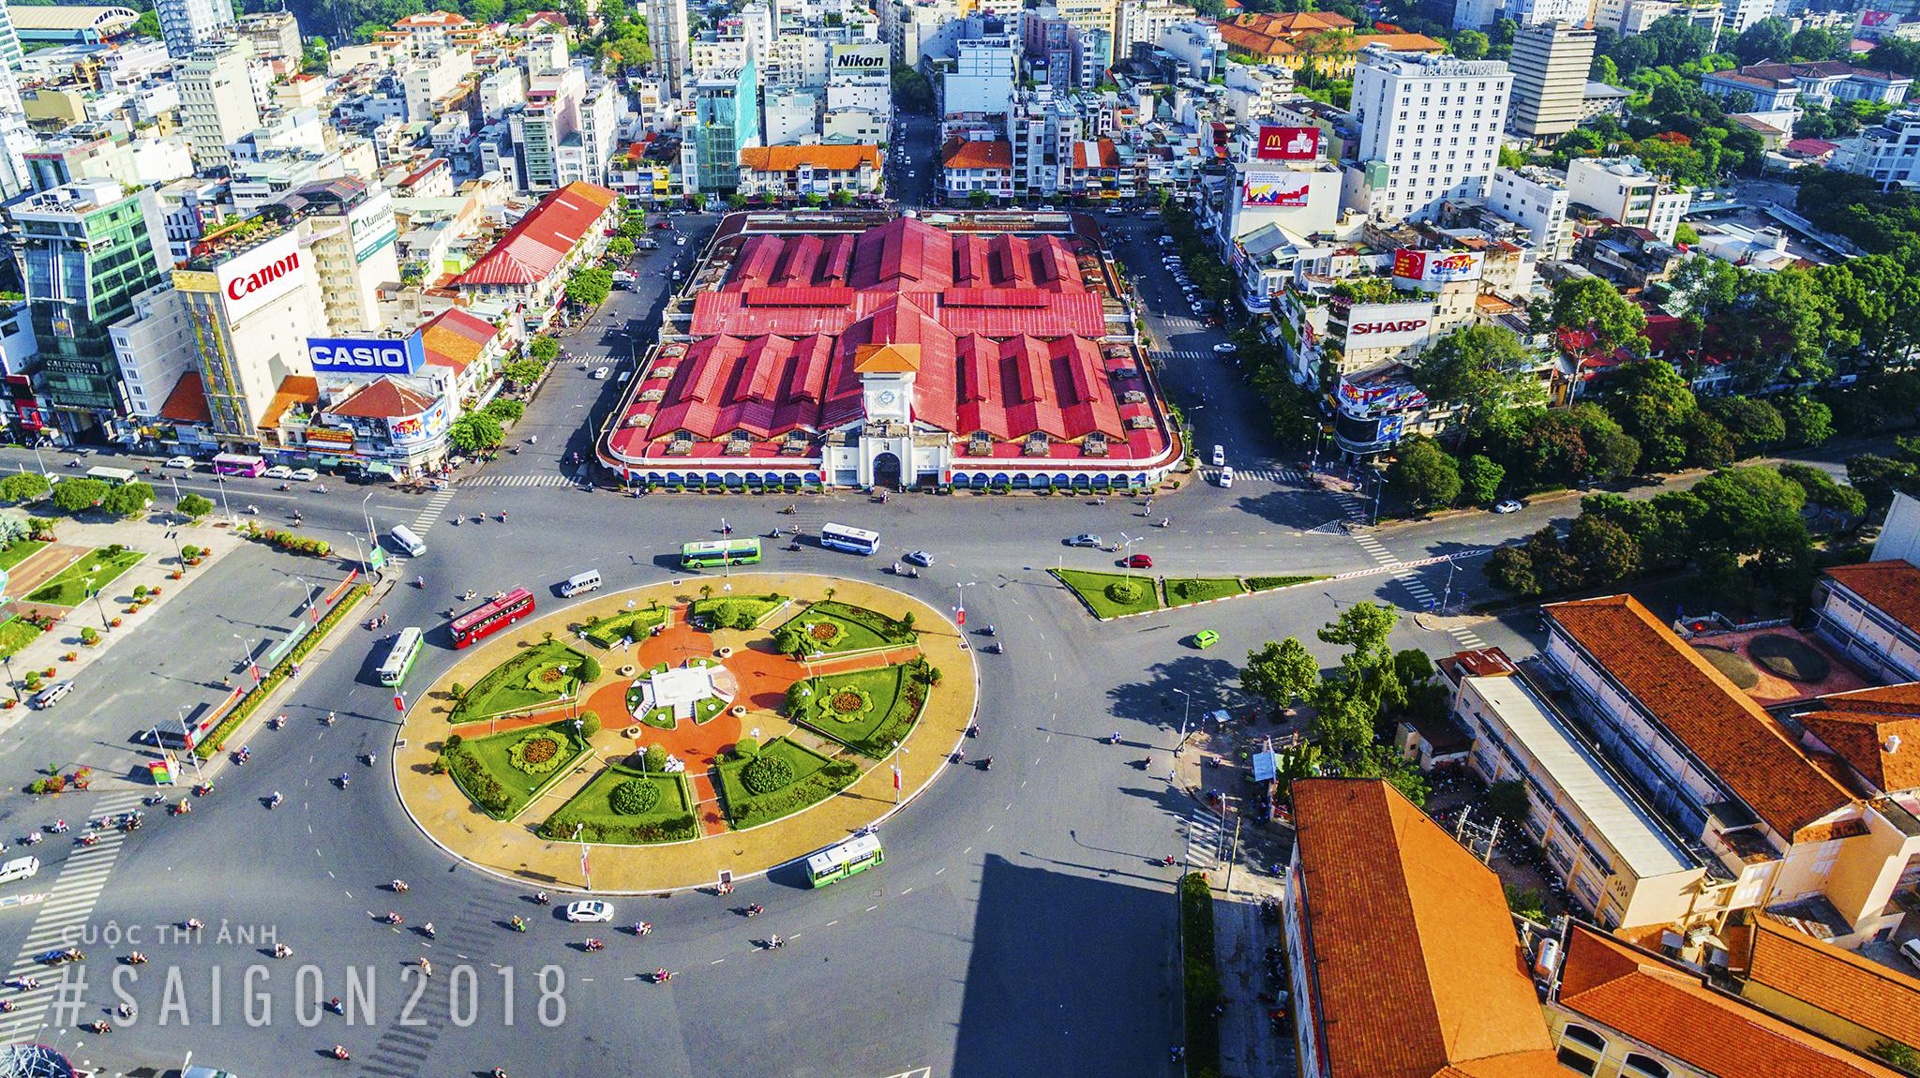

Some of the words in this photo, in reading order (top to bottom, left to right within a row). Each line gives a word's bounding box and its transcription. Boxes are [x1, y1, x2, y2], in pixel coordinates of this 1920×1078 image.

[838, 54, 884, 67] Nikon
[228, 252, 299, 301] Canon
[1351, 319, 1427, 335] SHARP
[309, 346, 405, 367] CASIO
[46, 360, 98, 371] CALIFORNIA
